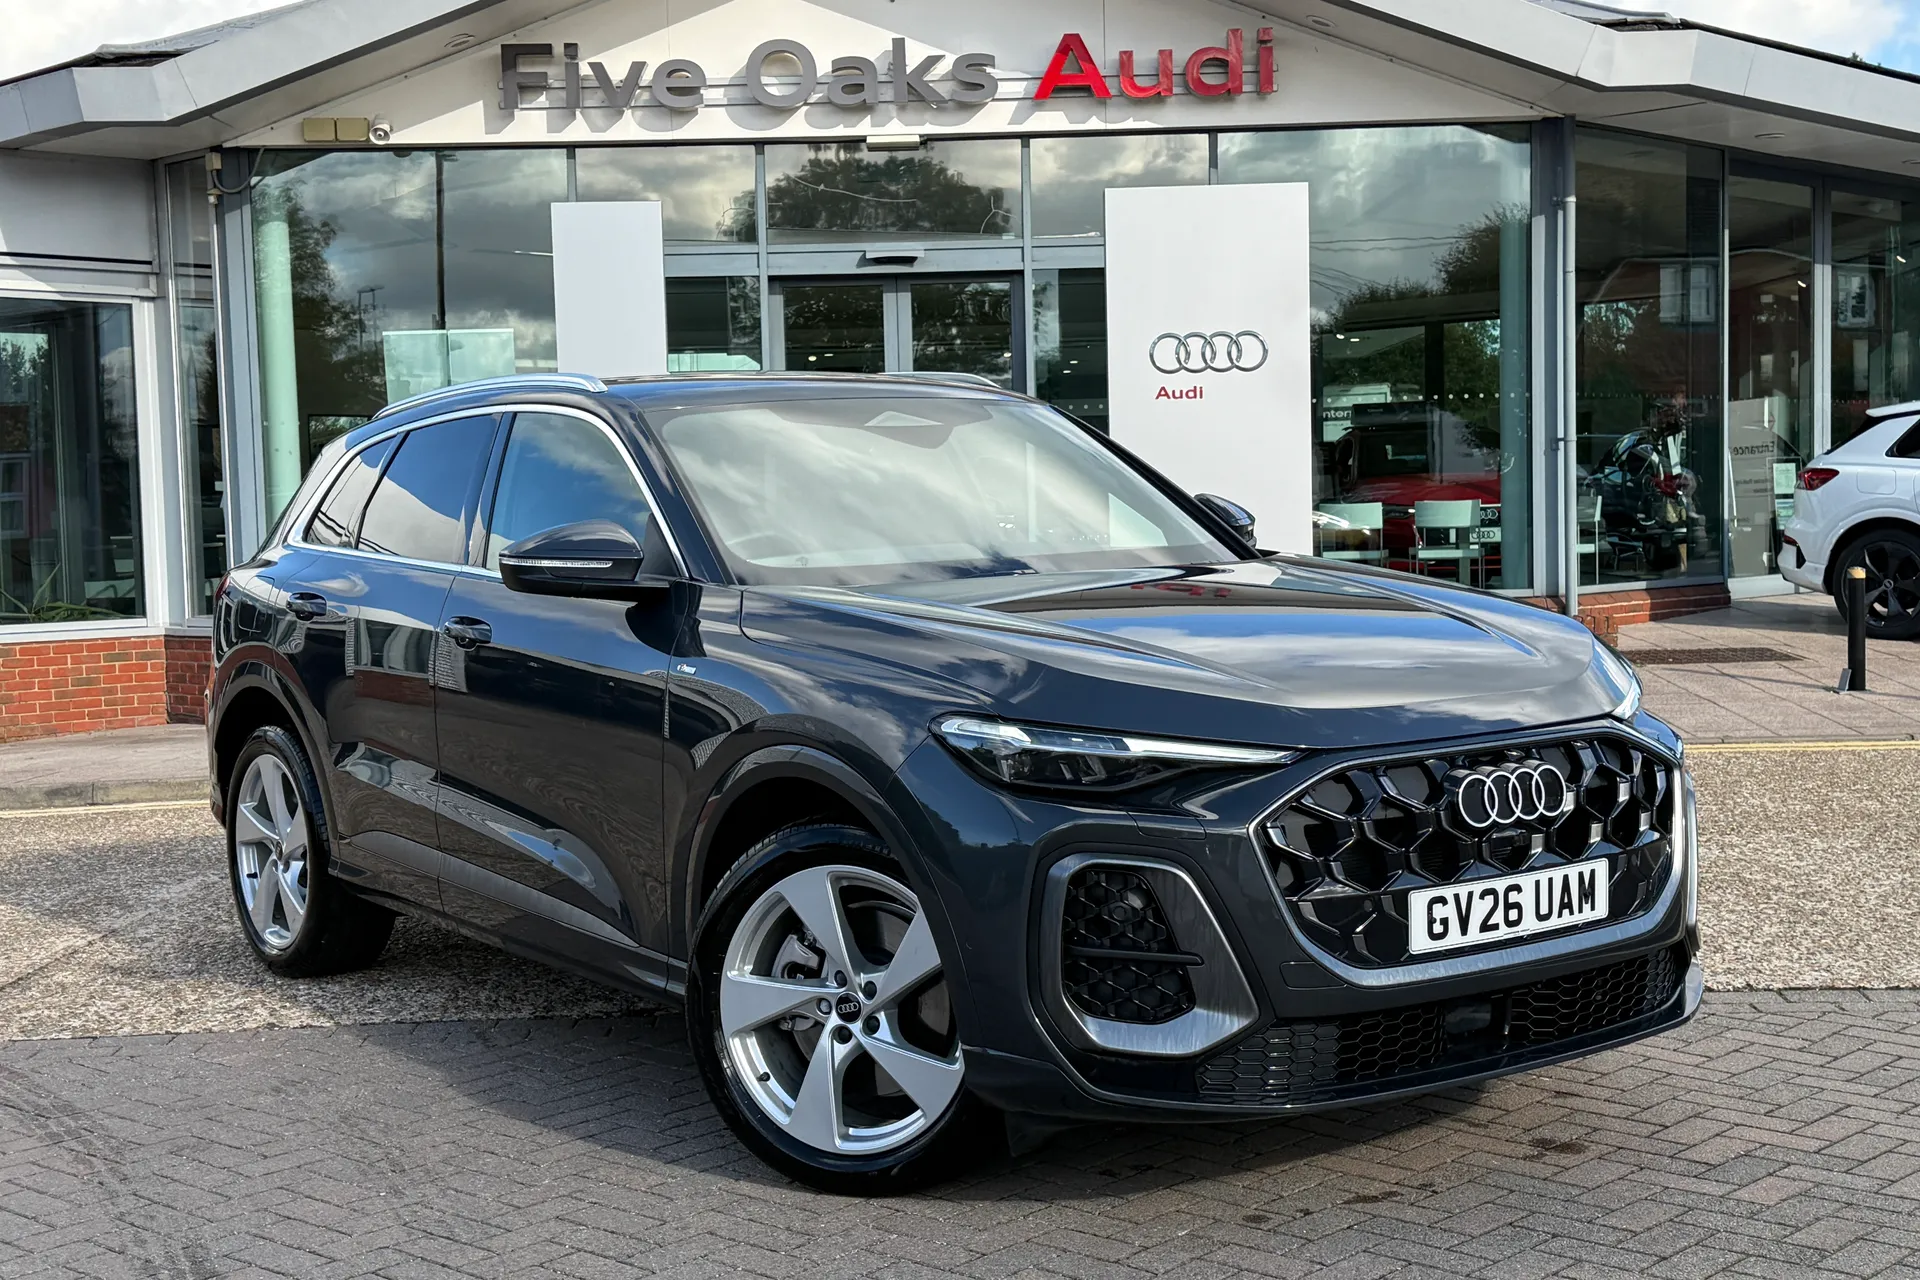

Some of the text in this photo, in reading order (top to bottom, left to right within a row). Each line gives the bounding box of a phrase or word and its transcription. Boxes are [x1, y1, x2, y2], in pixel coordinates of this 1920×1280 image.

[500, 27, 1274, 110] Five Oaks Audi
[1155, 386, 1203, 400] Audi
[1427, 868, 1596, 941] GV26 UAM
